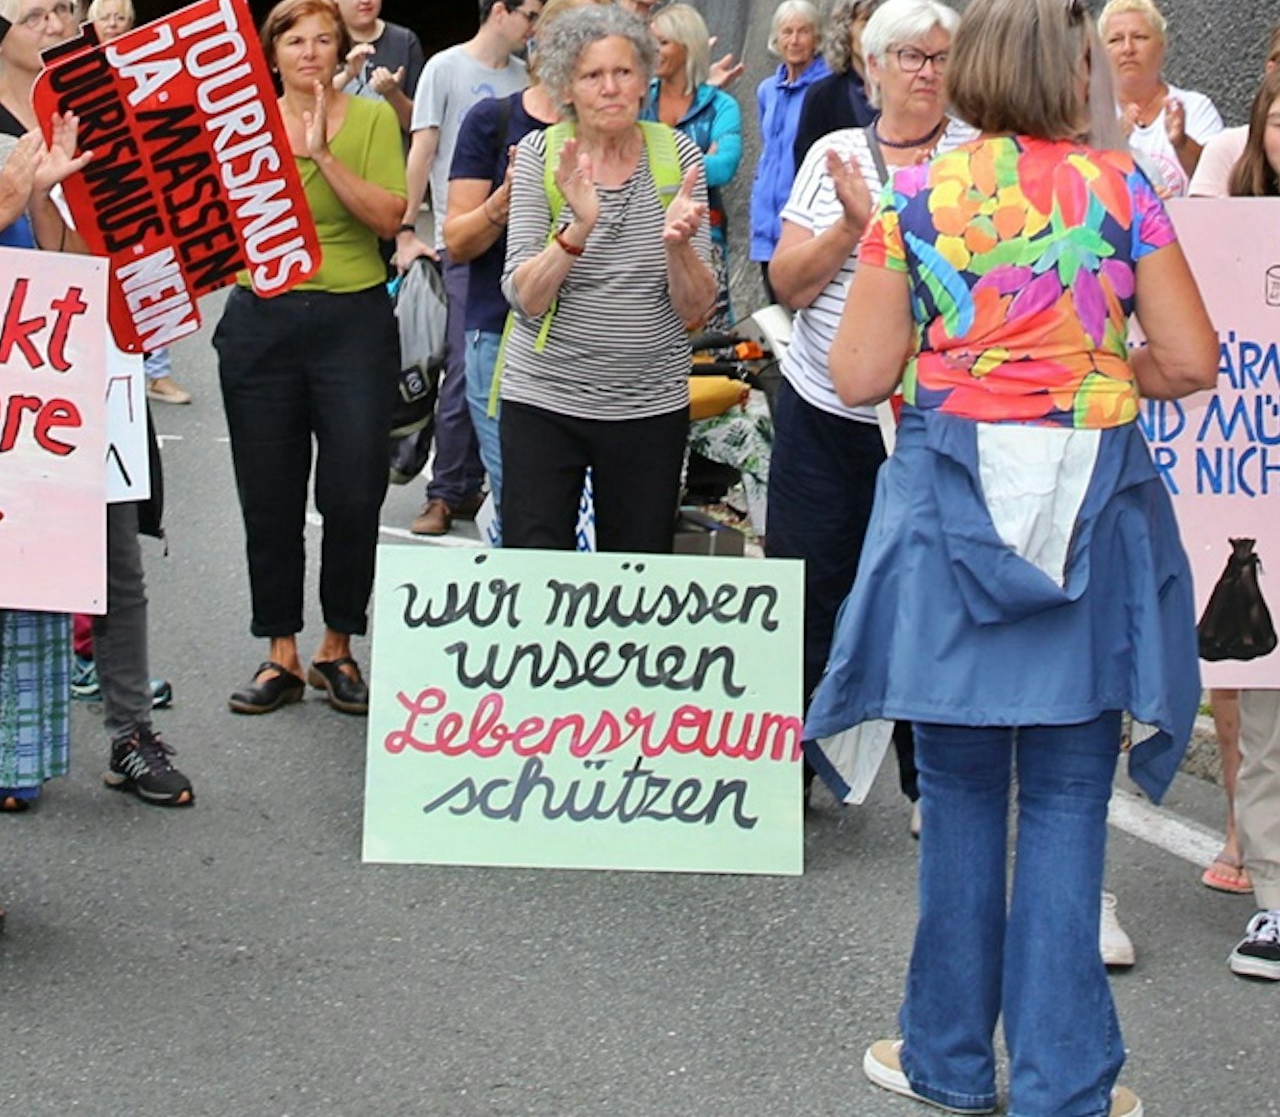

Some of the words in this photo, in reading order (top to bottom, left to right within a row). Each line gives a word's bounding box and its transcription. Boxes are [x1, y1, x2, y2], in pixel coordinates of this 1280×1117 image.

[116, 246, 200, 352] NEIN
[394, 554, 521, 628] wir
[545, 562, 779, 631] müssen
[444, 641, 746, 698] unseren
[384, 687, 804, 762] Lebensraum
[423, 756, 758, 829] schützen
